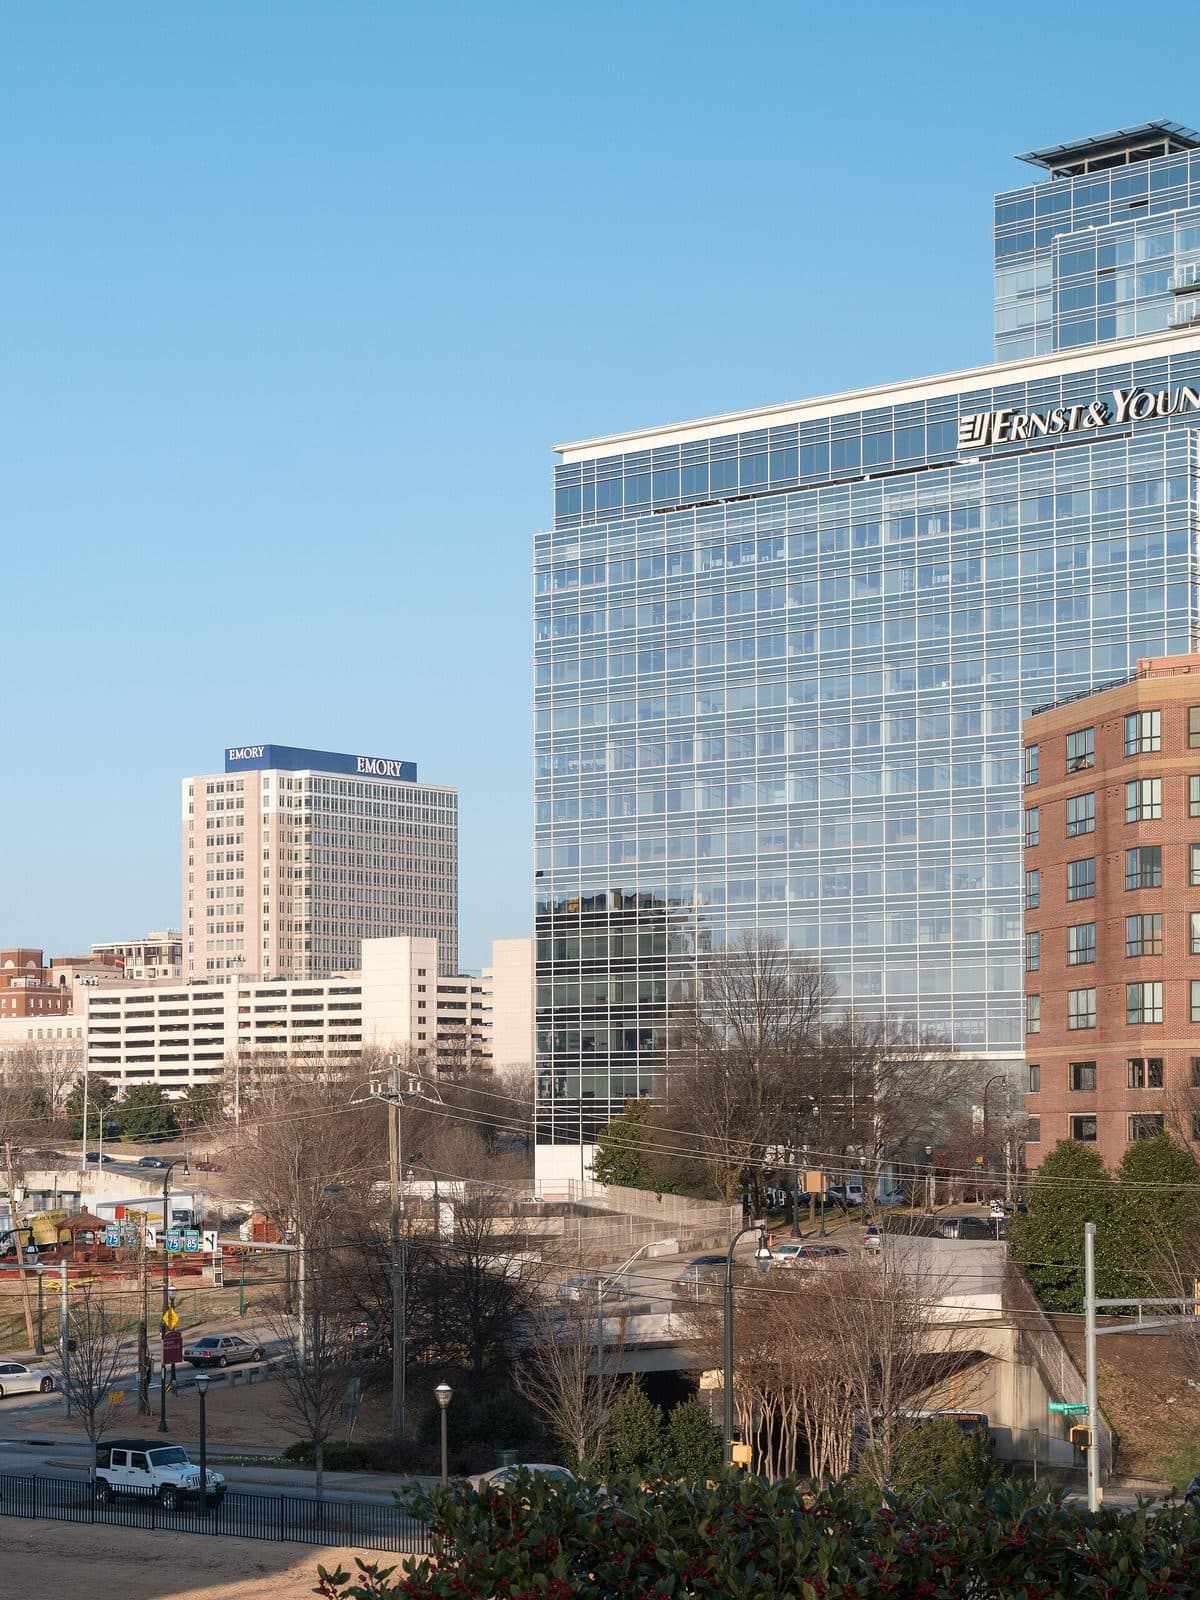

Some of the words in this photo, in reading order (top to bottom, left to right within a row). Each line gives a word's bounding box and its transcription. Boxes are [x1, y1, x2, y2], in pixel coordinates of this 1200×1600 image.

[229, 746, 265, 761] EMORY
[357, 757, 402, 777] EMORY
[109, 1235, 118, 1243] 75
[169, 1239, 179, 1248] 75
[187, 1239, 197, 1248] 85
